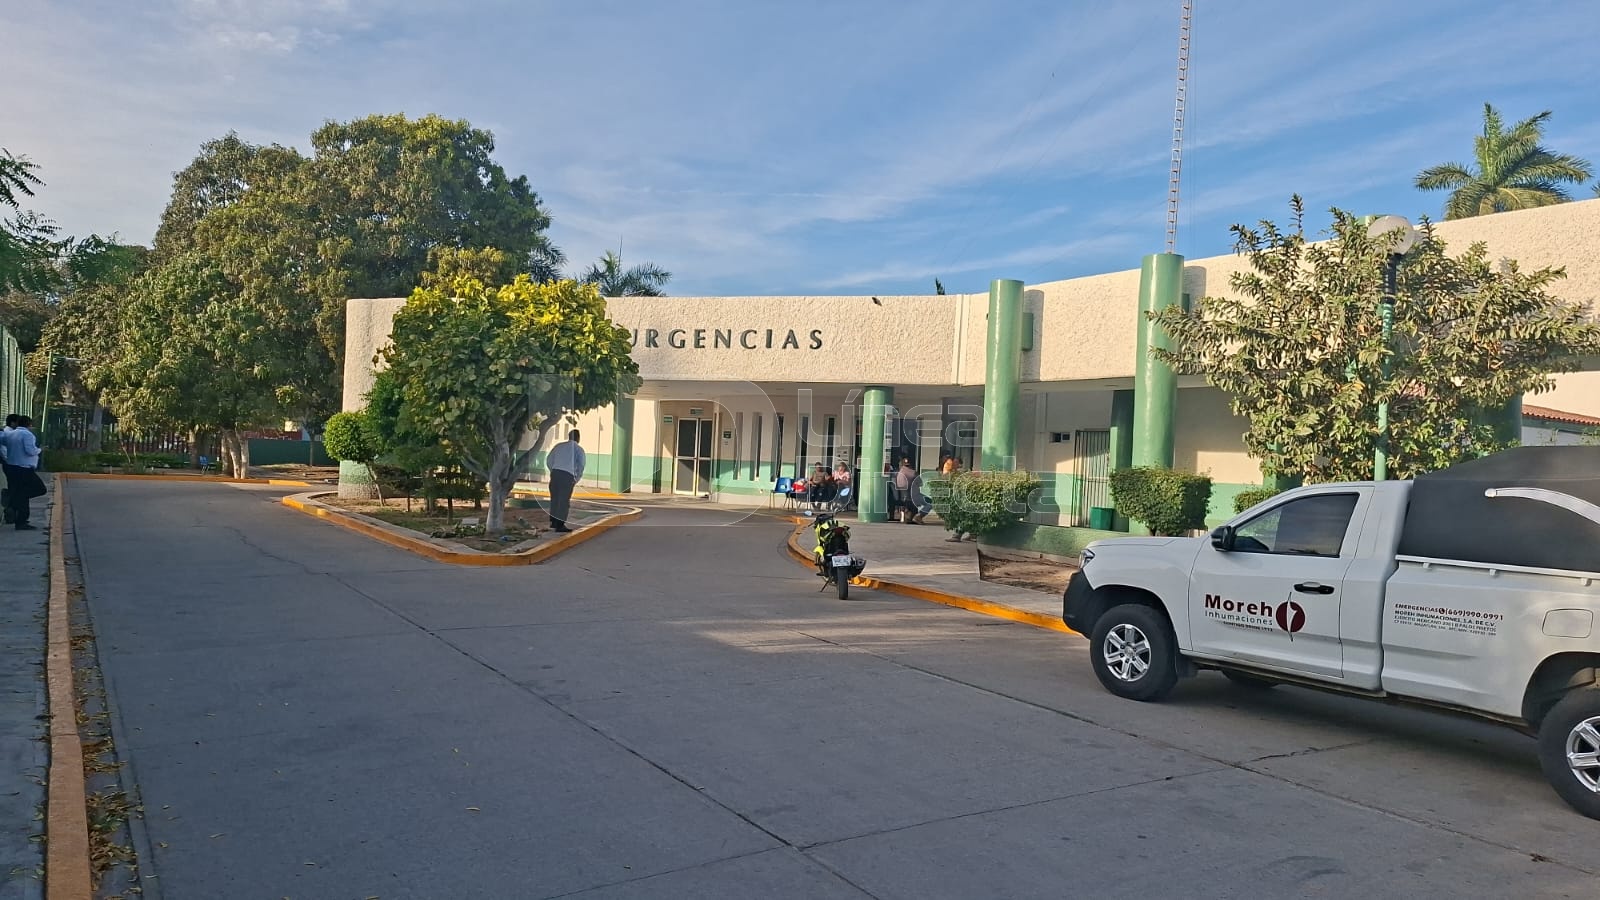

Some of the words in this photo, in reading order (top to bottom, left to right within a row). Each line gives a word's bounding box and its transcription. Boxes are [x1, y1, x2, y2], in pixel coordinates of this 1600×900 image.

[1204, 593, 1273, 618] Moreh
[1395, 603, 1439, 613] EMERGENCIAS
[1204, 610, 1273, 626] Inhumaciones
